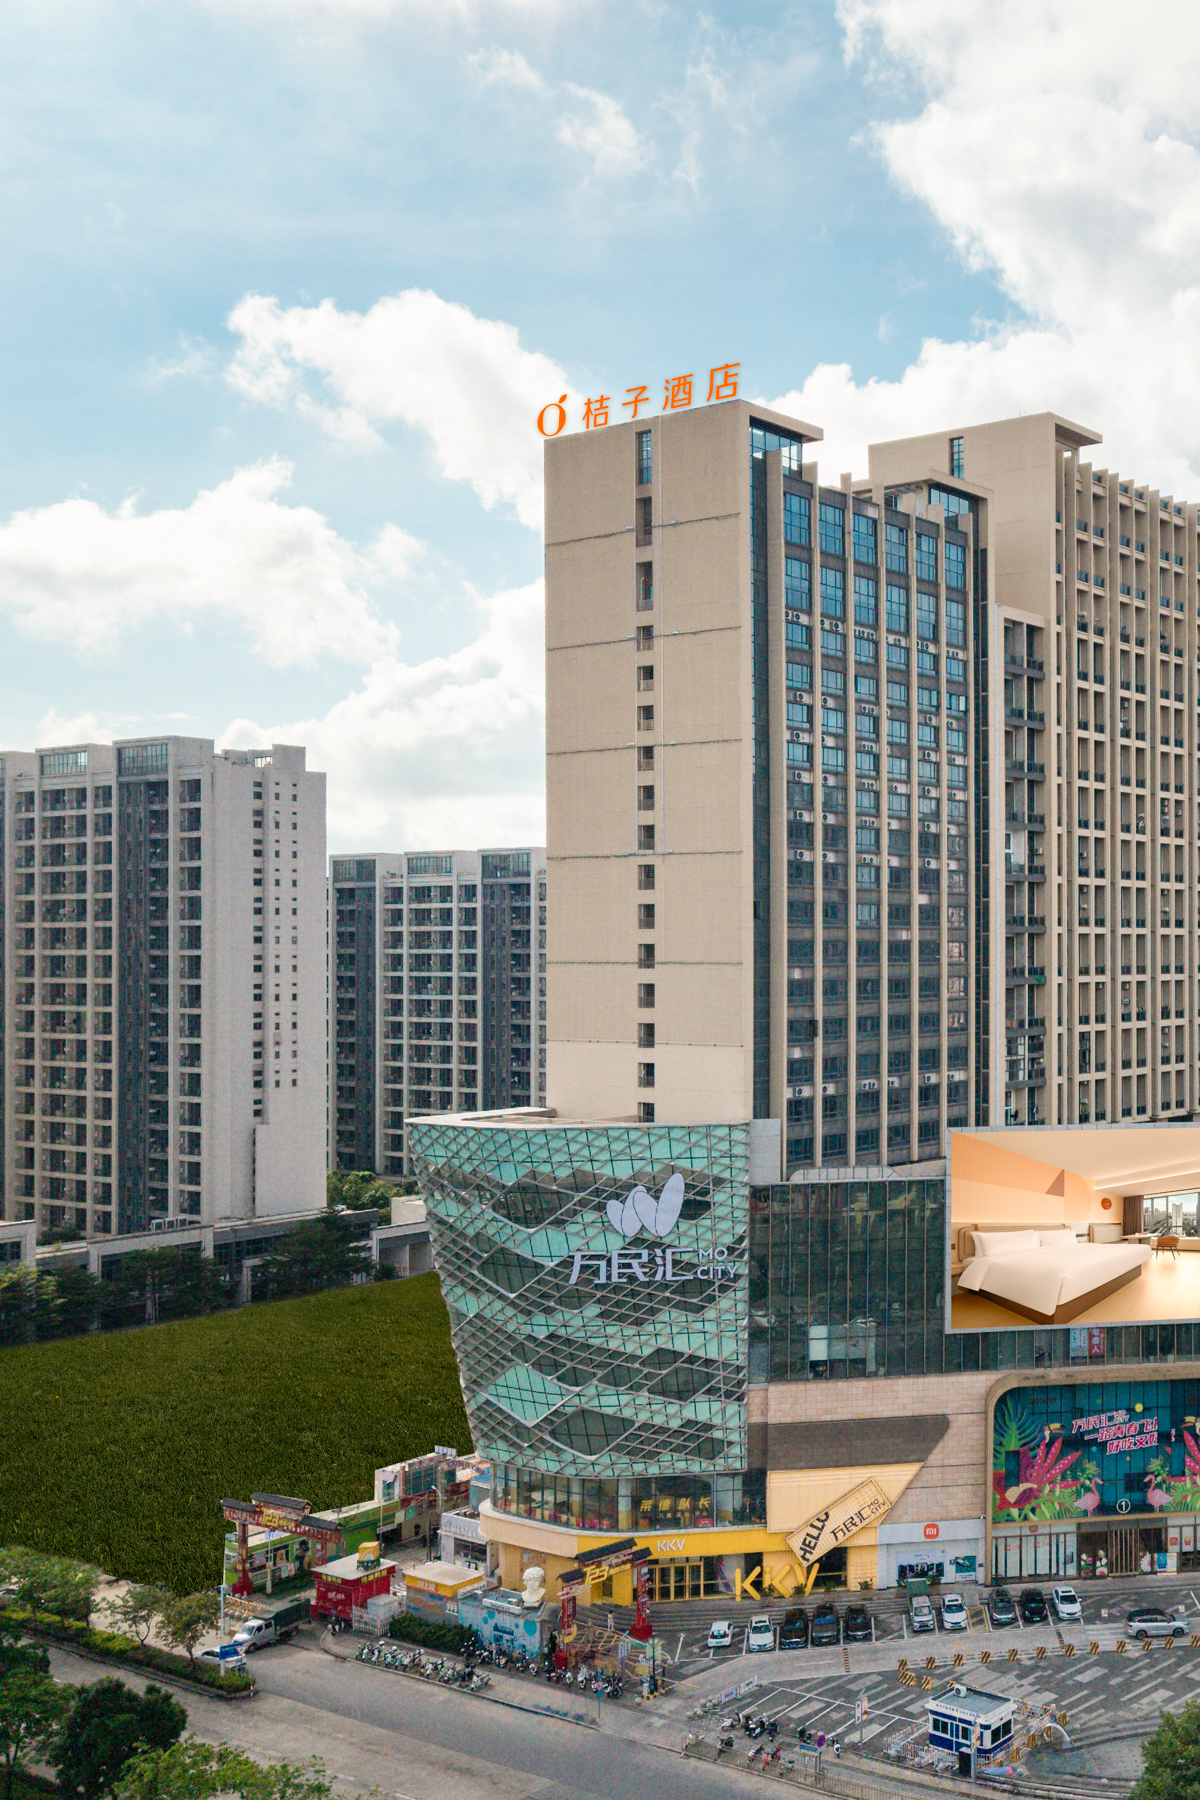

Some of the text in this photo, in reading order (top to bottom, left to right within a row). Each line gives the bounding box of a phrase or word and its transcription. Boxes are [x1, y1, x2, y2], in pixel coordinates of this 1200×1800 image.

[583, 362, 740, 429] 桔子酒店
[699, 1247, 728, 1261] MO
[568, 1248, 694, 1284] 万民汇
[697, 1266, 738, 1280] CITY
[1072, 1412, 1116, 1433] 万民汇
[867, 1498, 879, 1509] MO
[870, 1501, 887, 1516] CITY
[829, 1506, 873, 1542] 万民汇
[657, 1539, 686, 1552] KKV
[799, 1511, 830, 1564] HELLO
